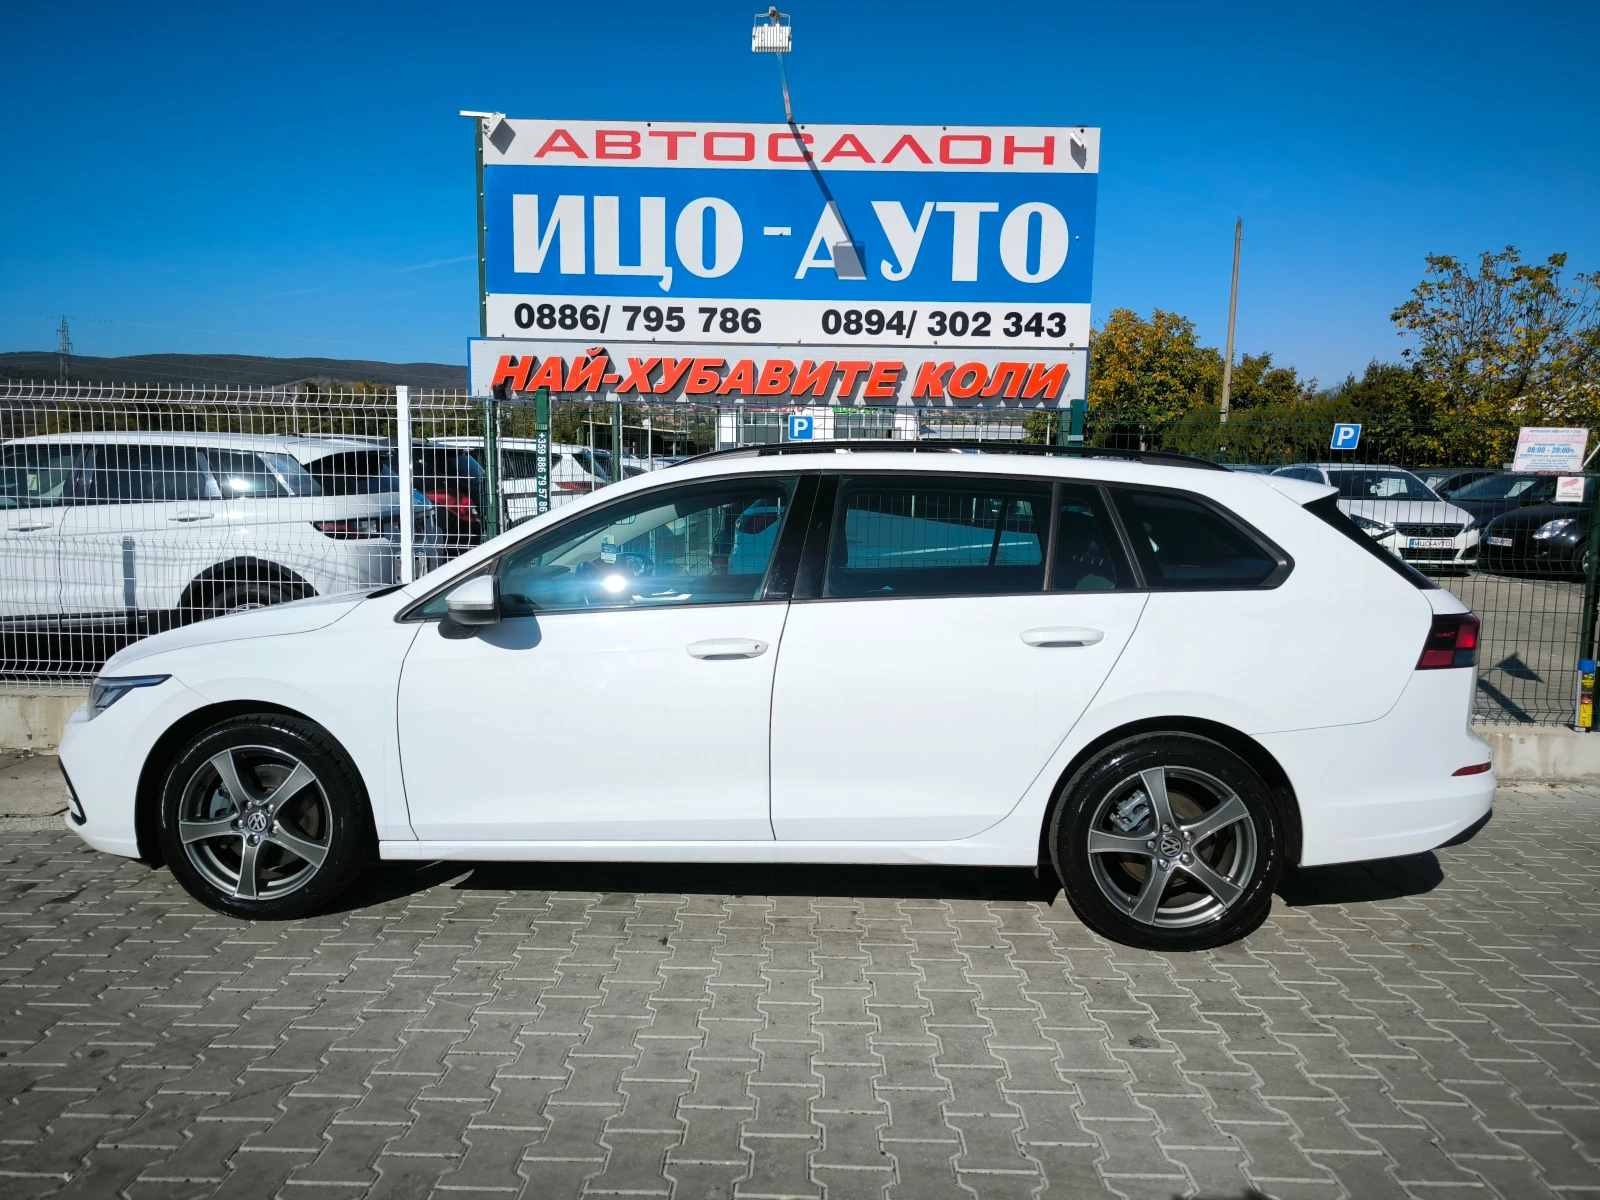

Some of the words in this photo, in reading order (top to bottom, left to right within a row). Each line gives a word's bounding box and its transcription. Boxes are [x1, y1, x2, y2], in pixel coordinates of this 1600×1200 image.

[534, 129, 1055, 166] АВТОСАЛОН
[514, 303, 611, 334] 0886/
[622, 305, 686, 333] 795
[698, 307, 762, 334] 786
[821, 308, 917, 339] 0894/
[927, 311, 992, 337] 302
[1002, 312, 1067, 338] 343
[490, 346, 904, 398] НАЙ-ХУБАВИТЕ
[911, 361, 1069, 399] КОЛИ
[793, 418, 809, 437] P
[1336, 427, 1355, 446] P
[537, 432, 547, 454] +359
[537, 457, 547, 473] 886
[538, 475, 547, 486] 79
[538, 488, 548, 499] 57
[538, 501, 548, 512] 86
